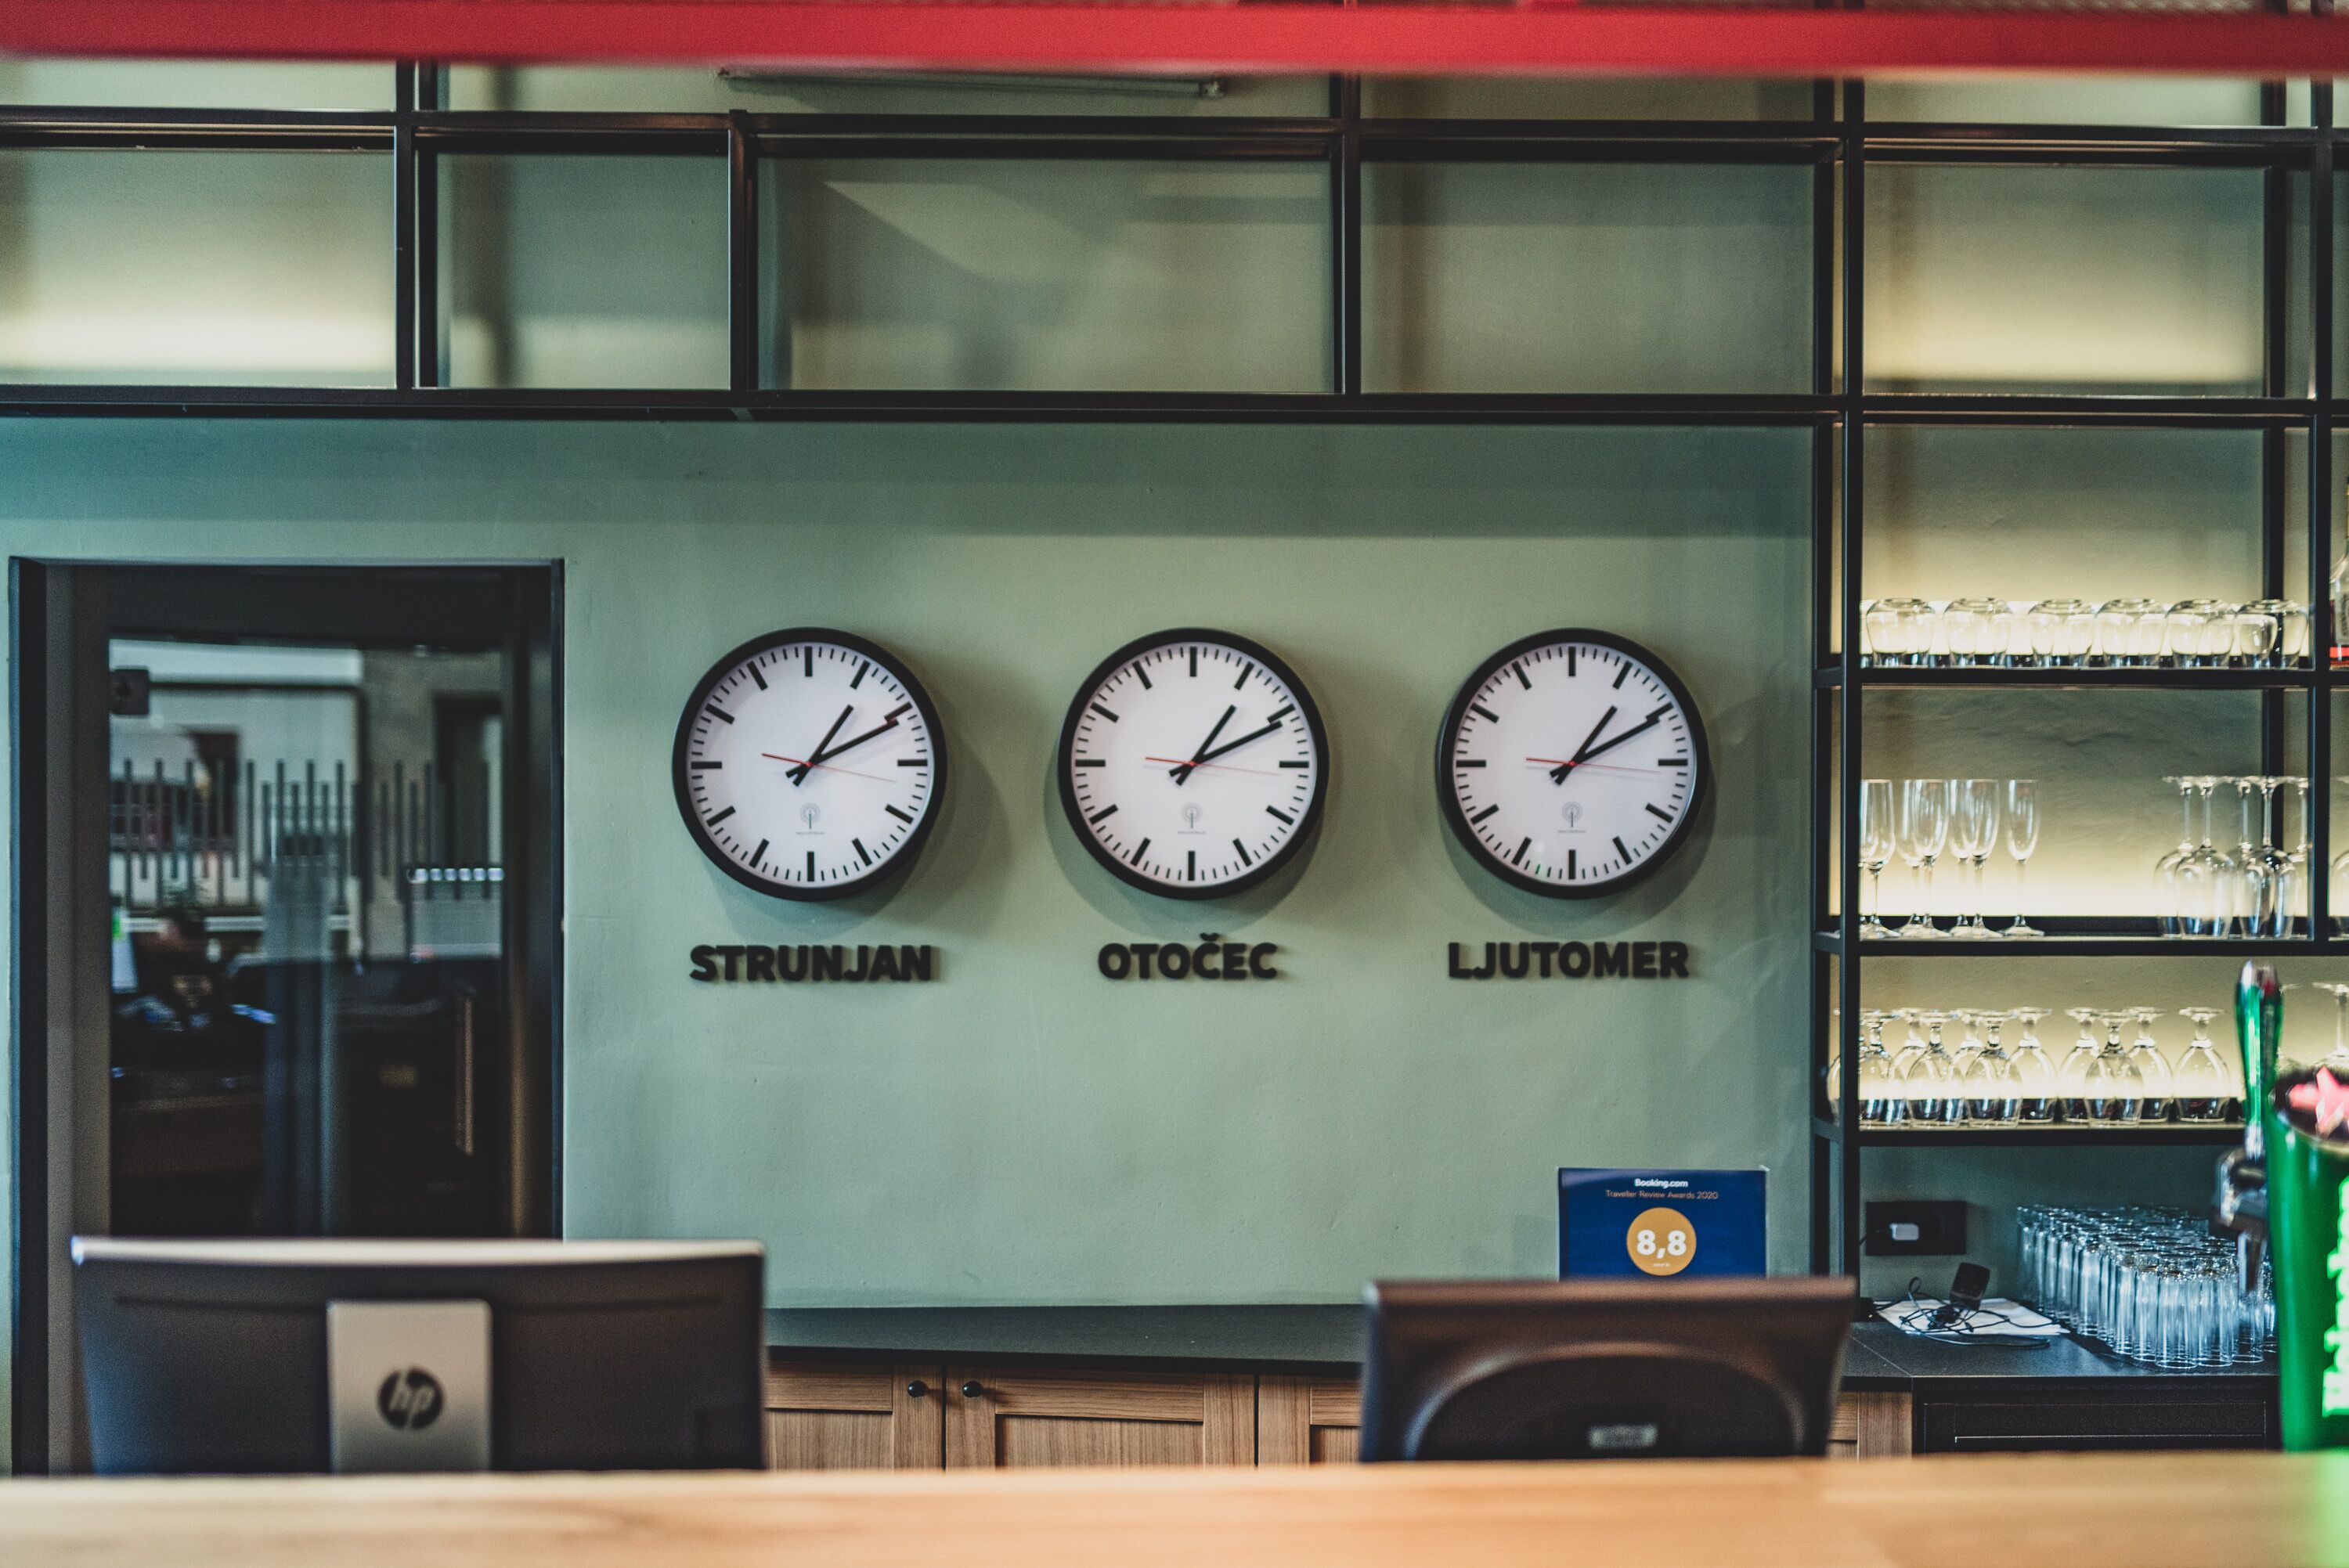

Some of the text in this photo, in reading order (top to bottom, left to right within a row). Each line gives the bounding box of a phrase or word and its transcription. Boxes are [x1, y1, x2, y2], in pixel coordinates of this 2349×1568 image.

[690, 945, 932, 982] STRUNJAN
[1098, 932, 1278, 980] OTOČEC
[1449, 942, 1690, 979] LJUTOMER
[1633, 1178, 1689, 1188] Booking.com
[1636, 1229, 1687, 1260] 8,8
